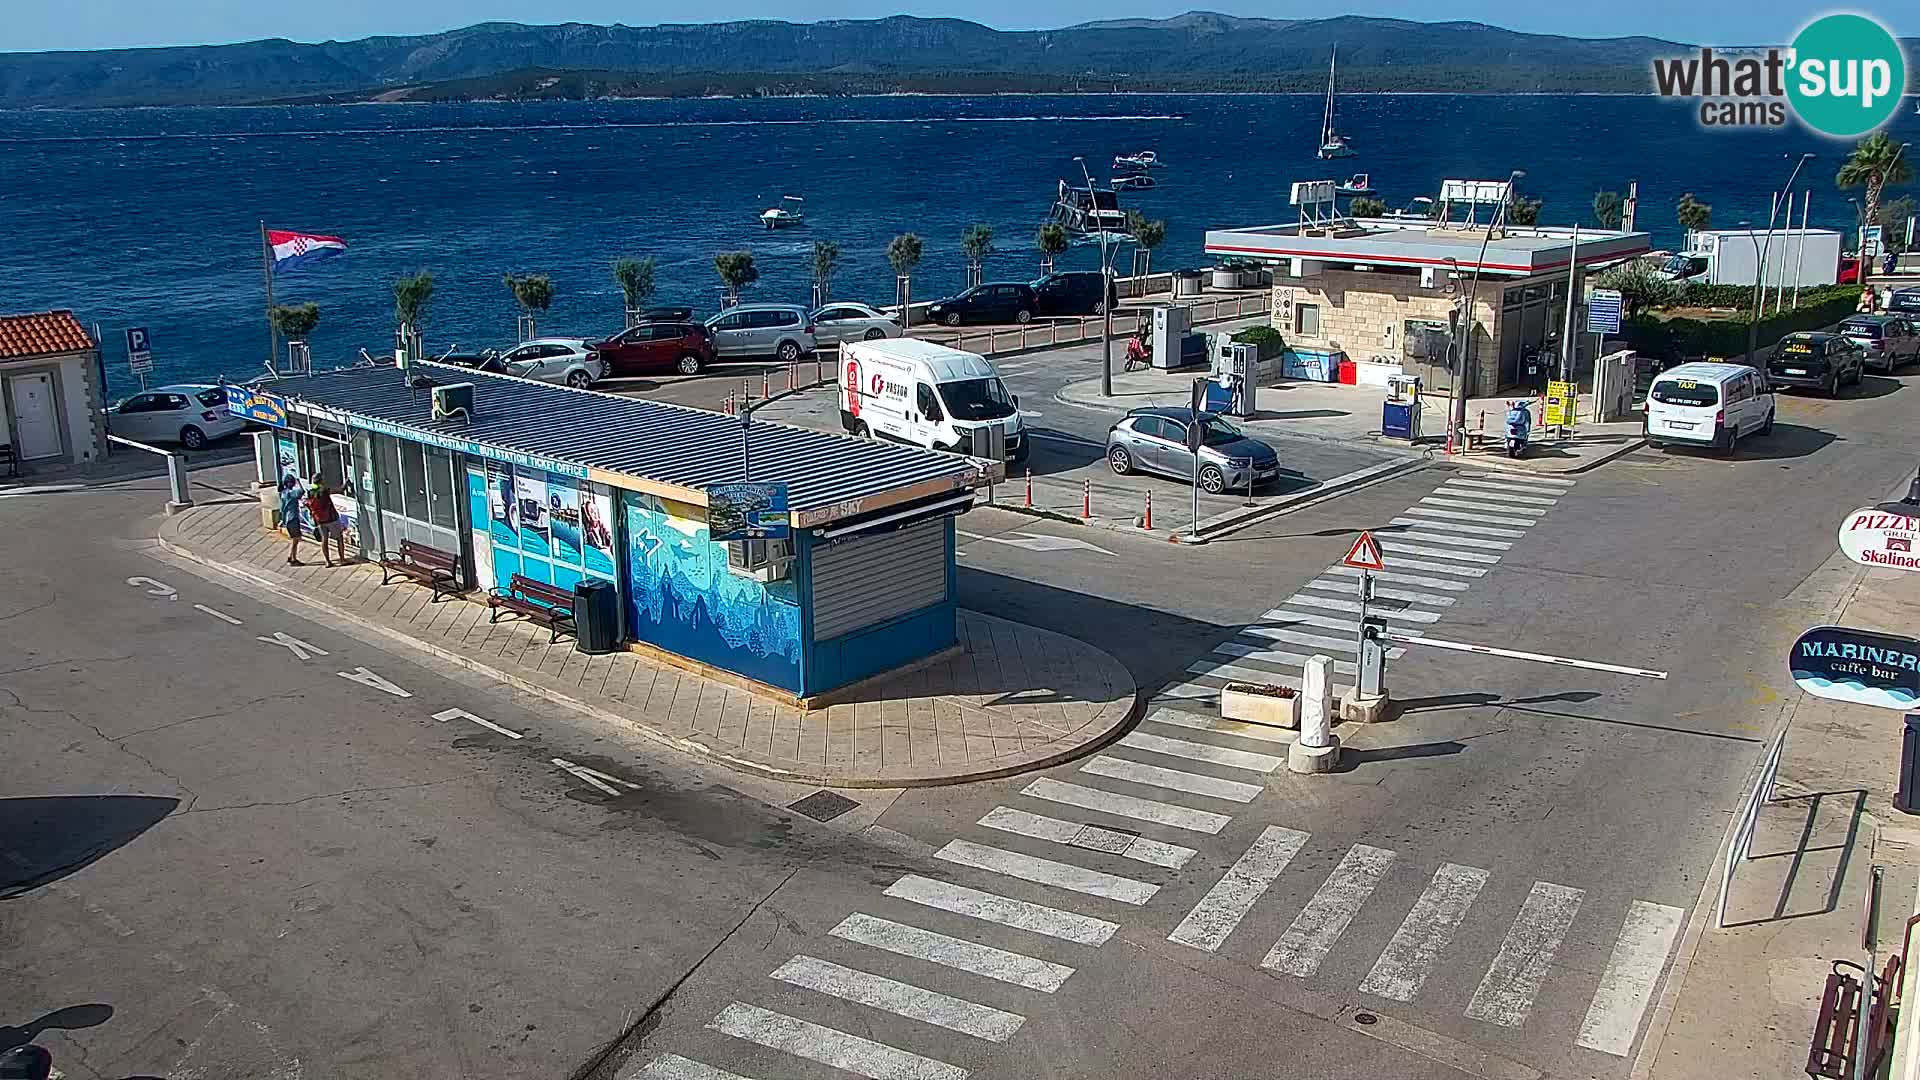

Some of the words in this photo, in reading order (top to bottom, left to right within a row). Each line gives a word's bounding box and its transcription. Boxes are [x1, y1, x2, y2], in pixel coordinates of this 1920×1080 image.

[132, 331, 144, 349] P
[886, 381, 908, 398] PASTOR
[1678, 381, 1697, 390] TAXI
[438, 437, 469, 452] POSTAJA
[480, 445, 495, 458] BUS
[495, 449, 528, 465] STATION
[530, 456, 556, 471] TICKET
[557, 463, 584, 477] OFFICE
[1849, 515, 1920, 532] PIZZE
[1883, 531, 1918, 540] GRILL
[1801, 641, 1920, 673] MARINER
[1830, 662, 1867, 675] caffe
[1871, 665, 1899, 680] bar
